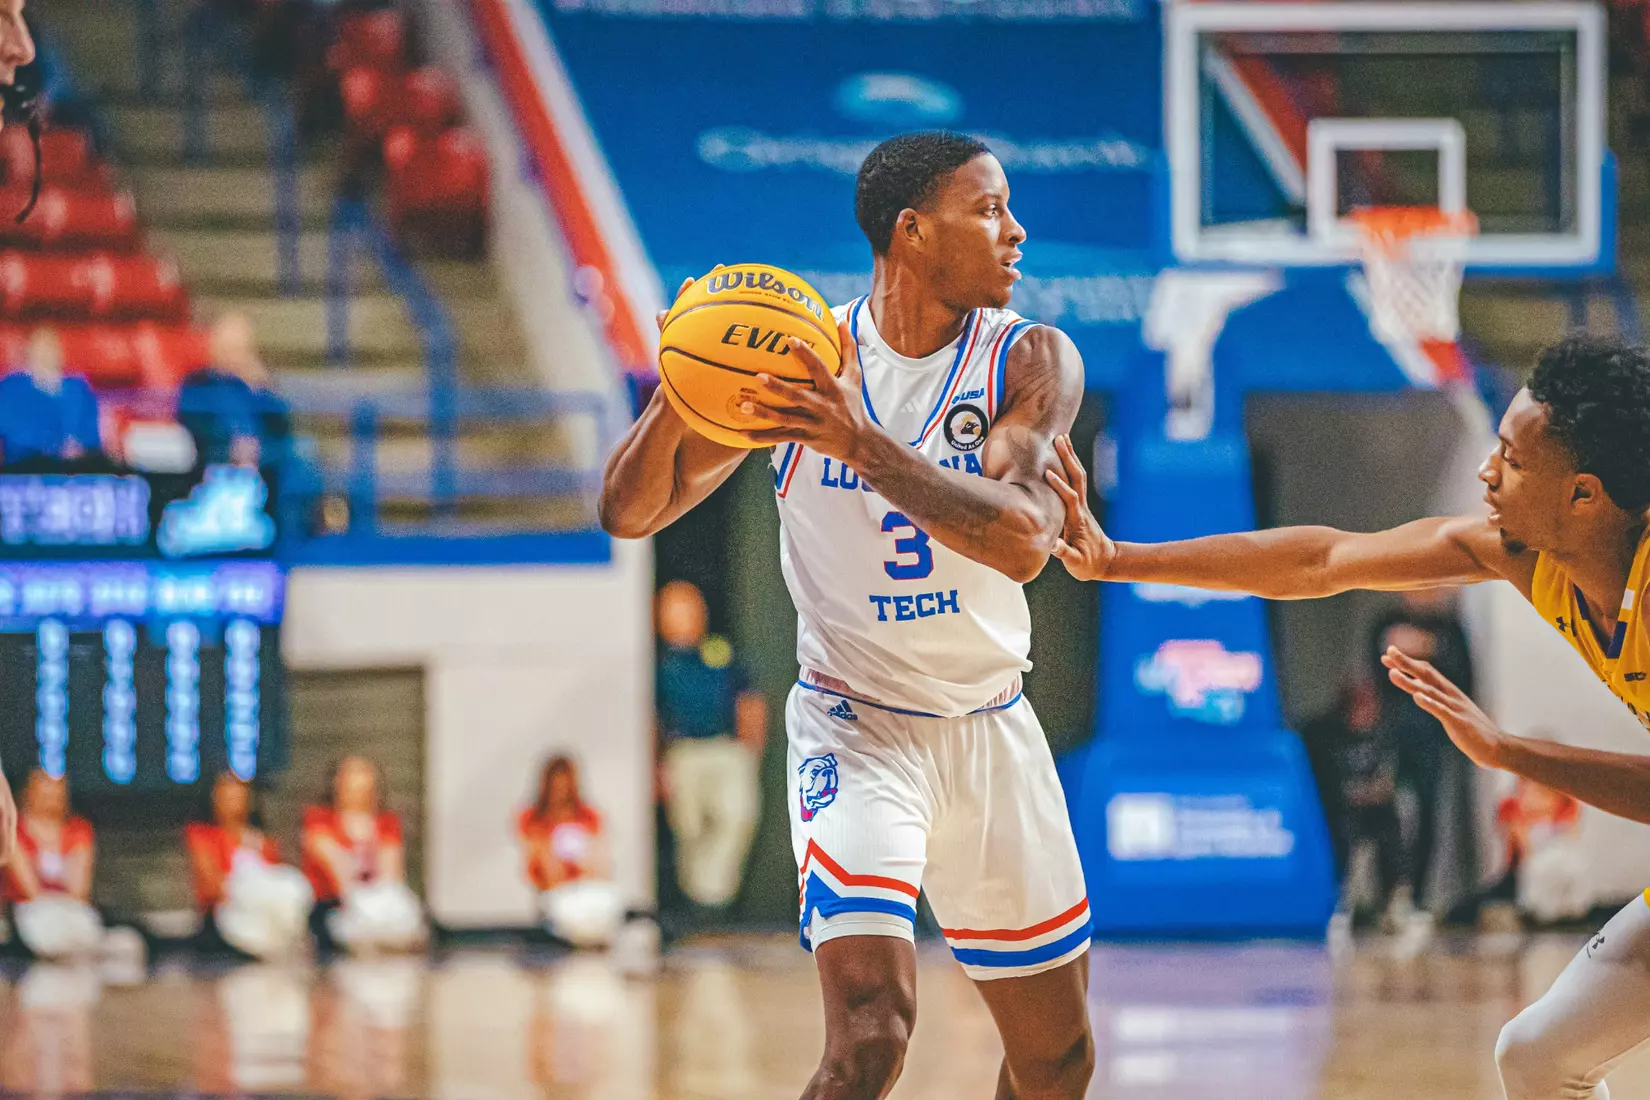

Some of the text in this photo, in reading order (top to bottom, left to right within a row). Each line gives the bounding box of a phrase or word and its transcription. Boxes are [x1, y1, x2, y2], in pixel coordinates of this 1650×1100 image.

[706, 271, 823, 321] Wilson
[951, 439, 968, 450] United
[881, 511, 934, 580] 3
[869, 589, 960, 621] TECH
